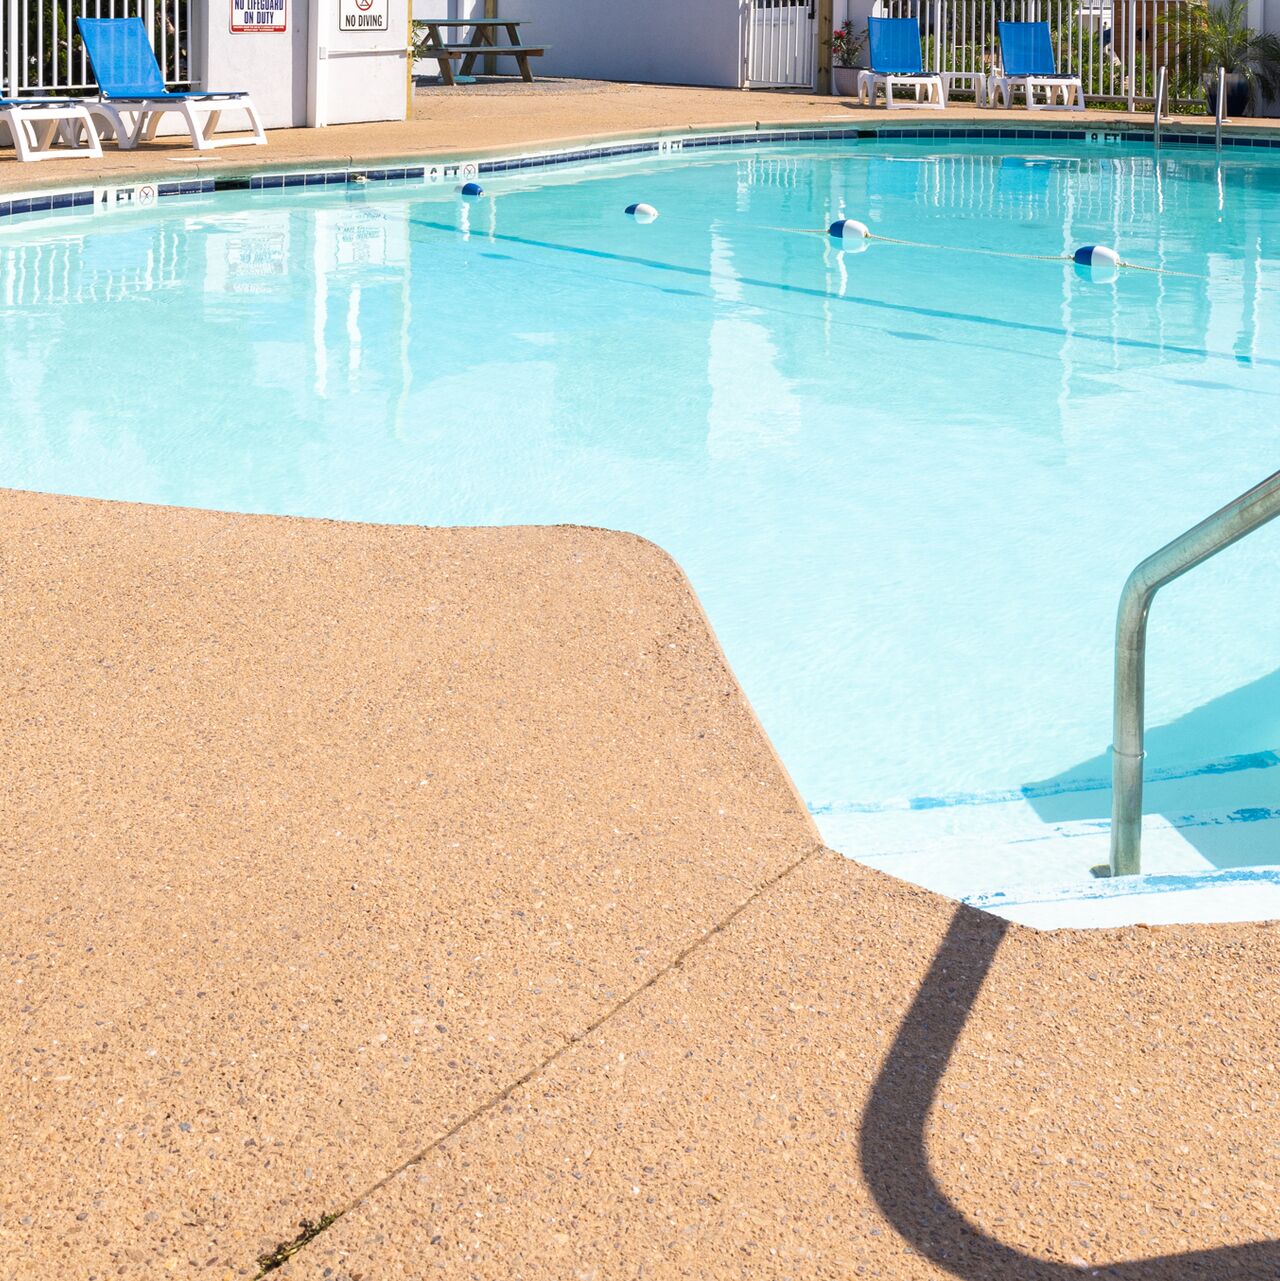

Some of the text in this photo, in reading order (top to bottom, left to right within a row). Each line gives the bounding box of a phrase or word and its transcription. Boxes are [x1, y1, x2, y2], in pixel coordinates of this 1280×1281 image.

[244, 11, 274, 24] ON DUTY
[345, 14, 383, 27] NO DIVING
